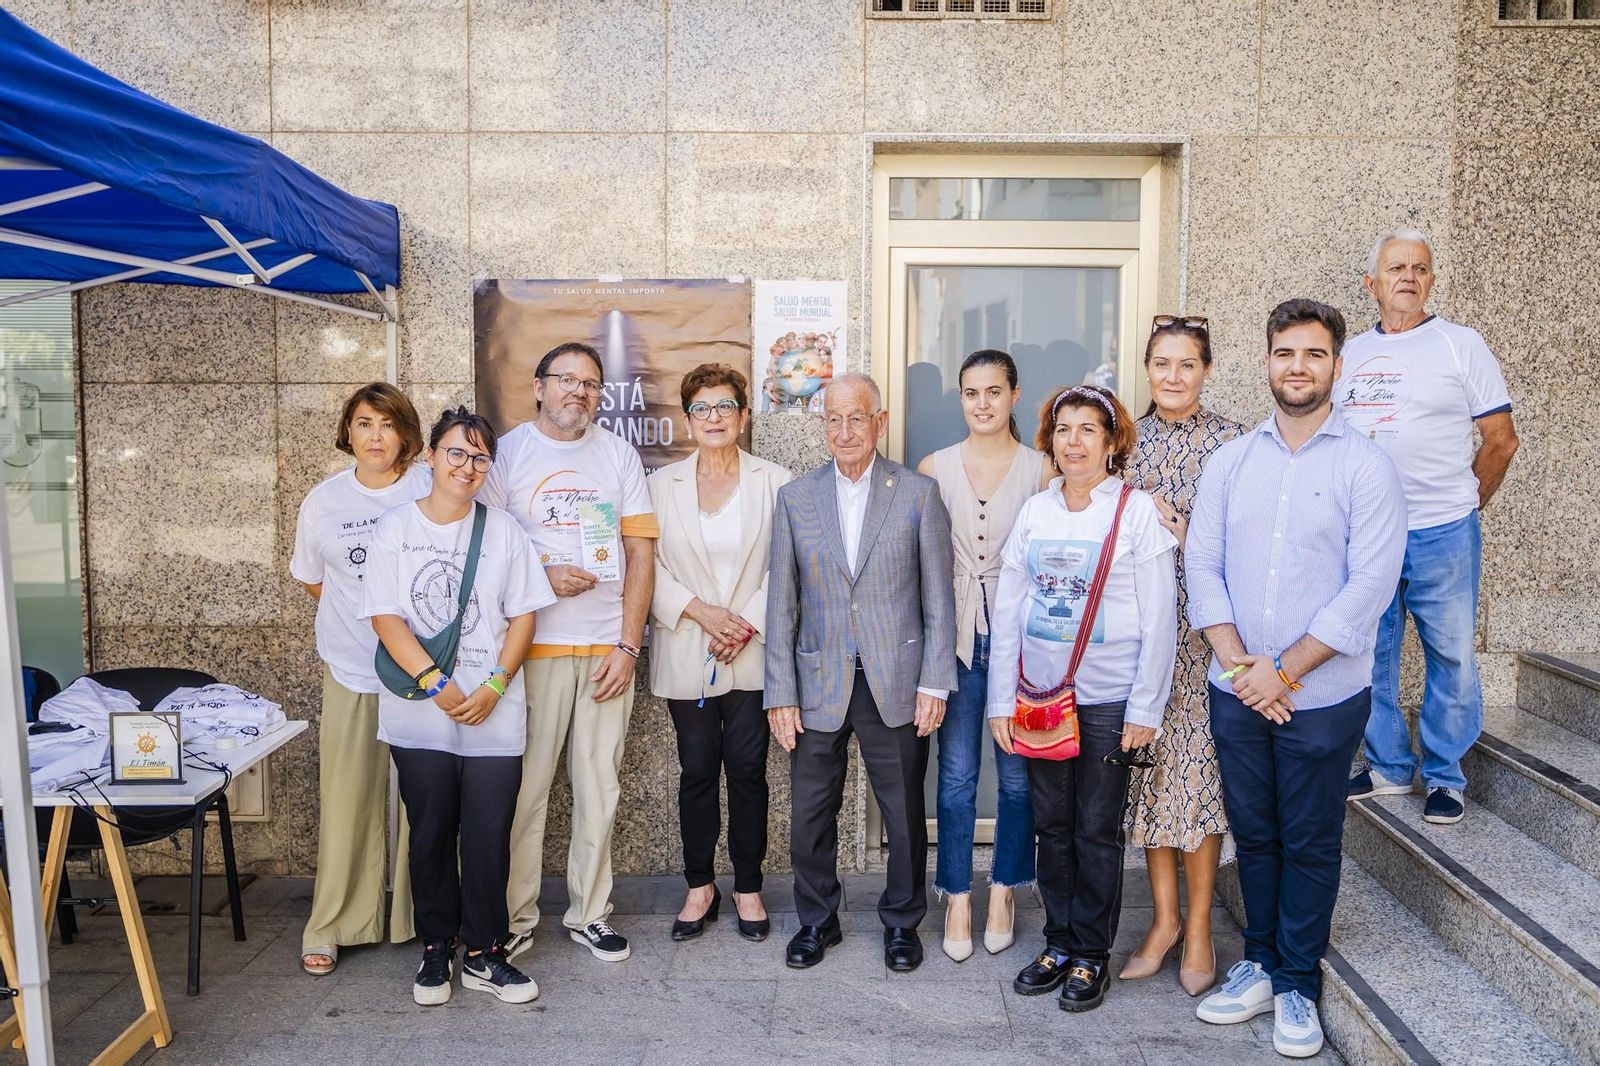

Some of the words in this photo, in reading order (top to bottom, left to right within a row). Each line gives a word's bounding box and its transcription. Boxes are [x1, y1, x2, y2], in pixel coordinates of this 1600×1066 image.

[773, 295, 799, 306] SALUD
[801, 296, 832, 307] MENTAL
[773, 307, 797, 317] SALUD
[799, 307, 832, 317] MUNDIAL
[1366, 374, 1402, 389] Noche
[1369, 388, 1397, 401] Día
[541, 494, 554, 502] De
[556, 493, 563, 501] la
[564, 490, 600, 507] Noche
[356, 519, 368, 527] LA
[337, 530, 357, 539] Carrera
[357, 529, 367, 537] por
[142, 758, 167, 767] Timón
